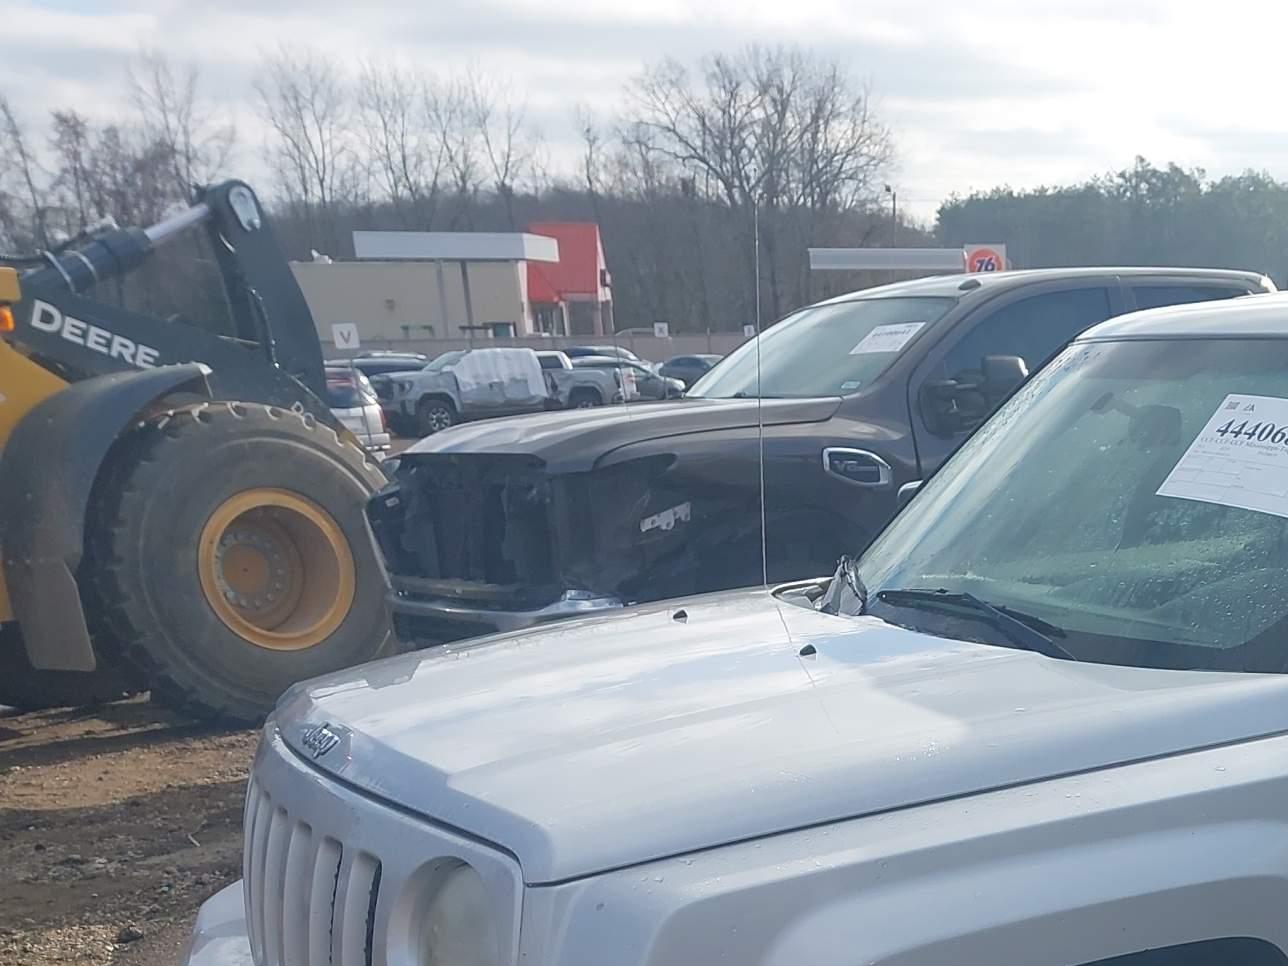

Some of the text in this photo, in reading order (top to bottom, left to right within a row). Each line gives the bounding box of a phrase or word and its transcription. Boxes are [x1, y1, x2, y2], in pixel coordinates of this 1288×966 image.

[975, 256, 996, 272] 76
[31, 299, 160, 368] DEERE
[340, 331, 351, 344] V
[303, 727, 341, 759] Jeep
